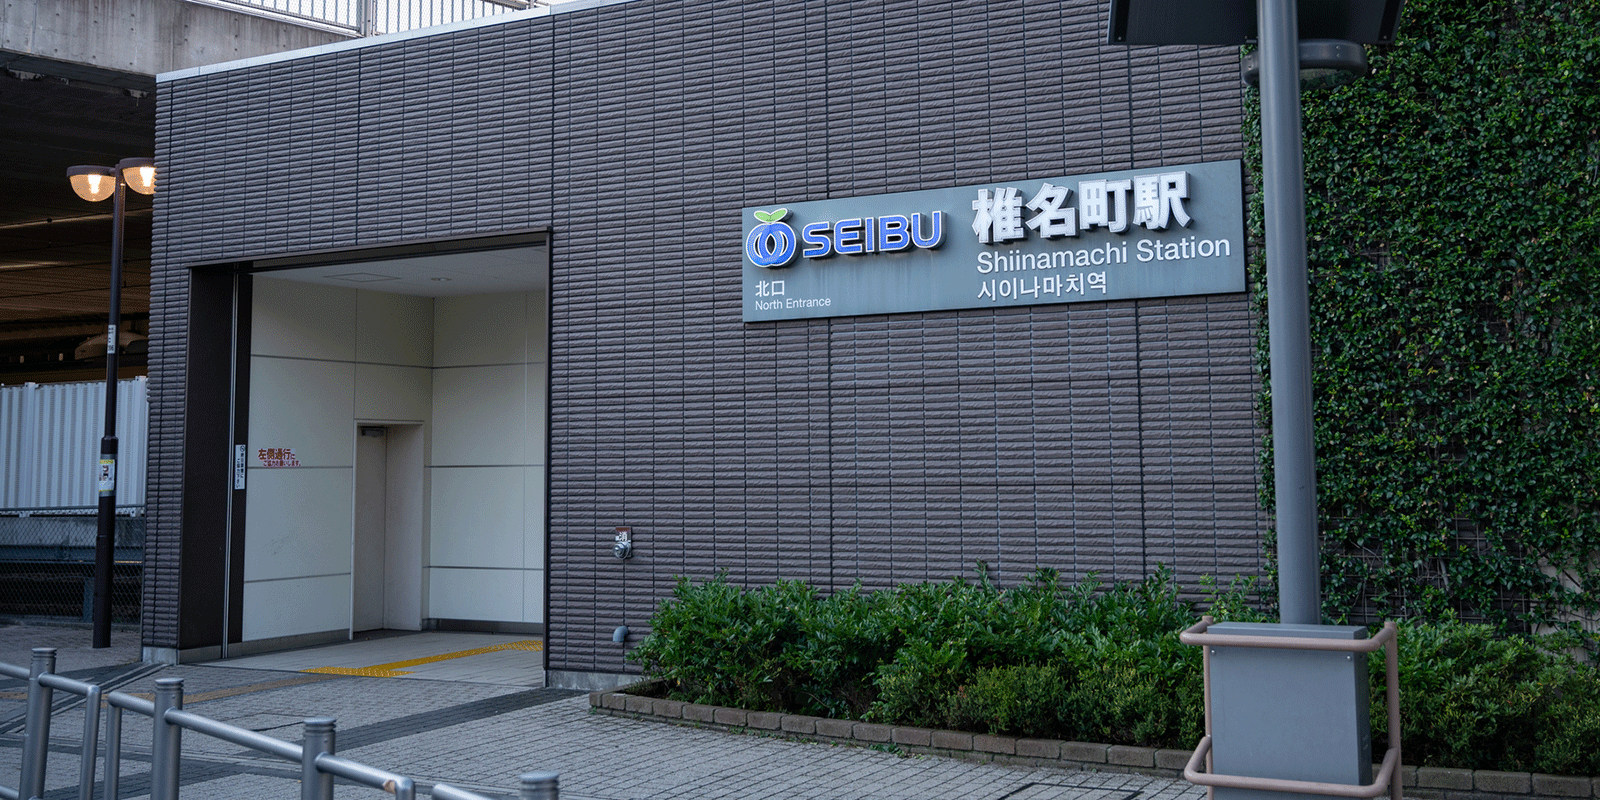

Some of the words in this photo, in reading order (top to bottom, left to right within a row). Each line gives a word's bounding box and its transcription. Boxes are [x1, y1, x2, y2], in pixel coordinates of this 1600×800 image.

[971, 170, 1193, 245] 椎名町駅
[802, 210, 943, 258] SEIBU
[976, 241, 1127, 274] Shiinamachi
[1136, 235, 1231, 262] Station
[755, 280, 785, 298] 北口
[977, 271, 1107, 301] 시이나마치역
[755, 300, 783, 311] North
[786, 297, 831, 309] Entrance
[258, 448, 296, 460] 左側通行に
